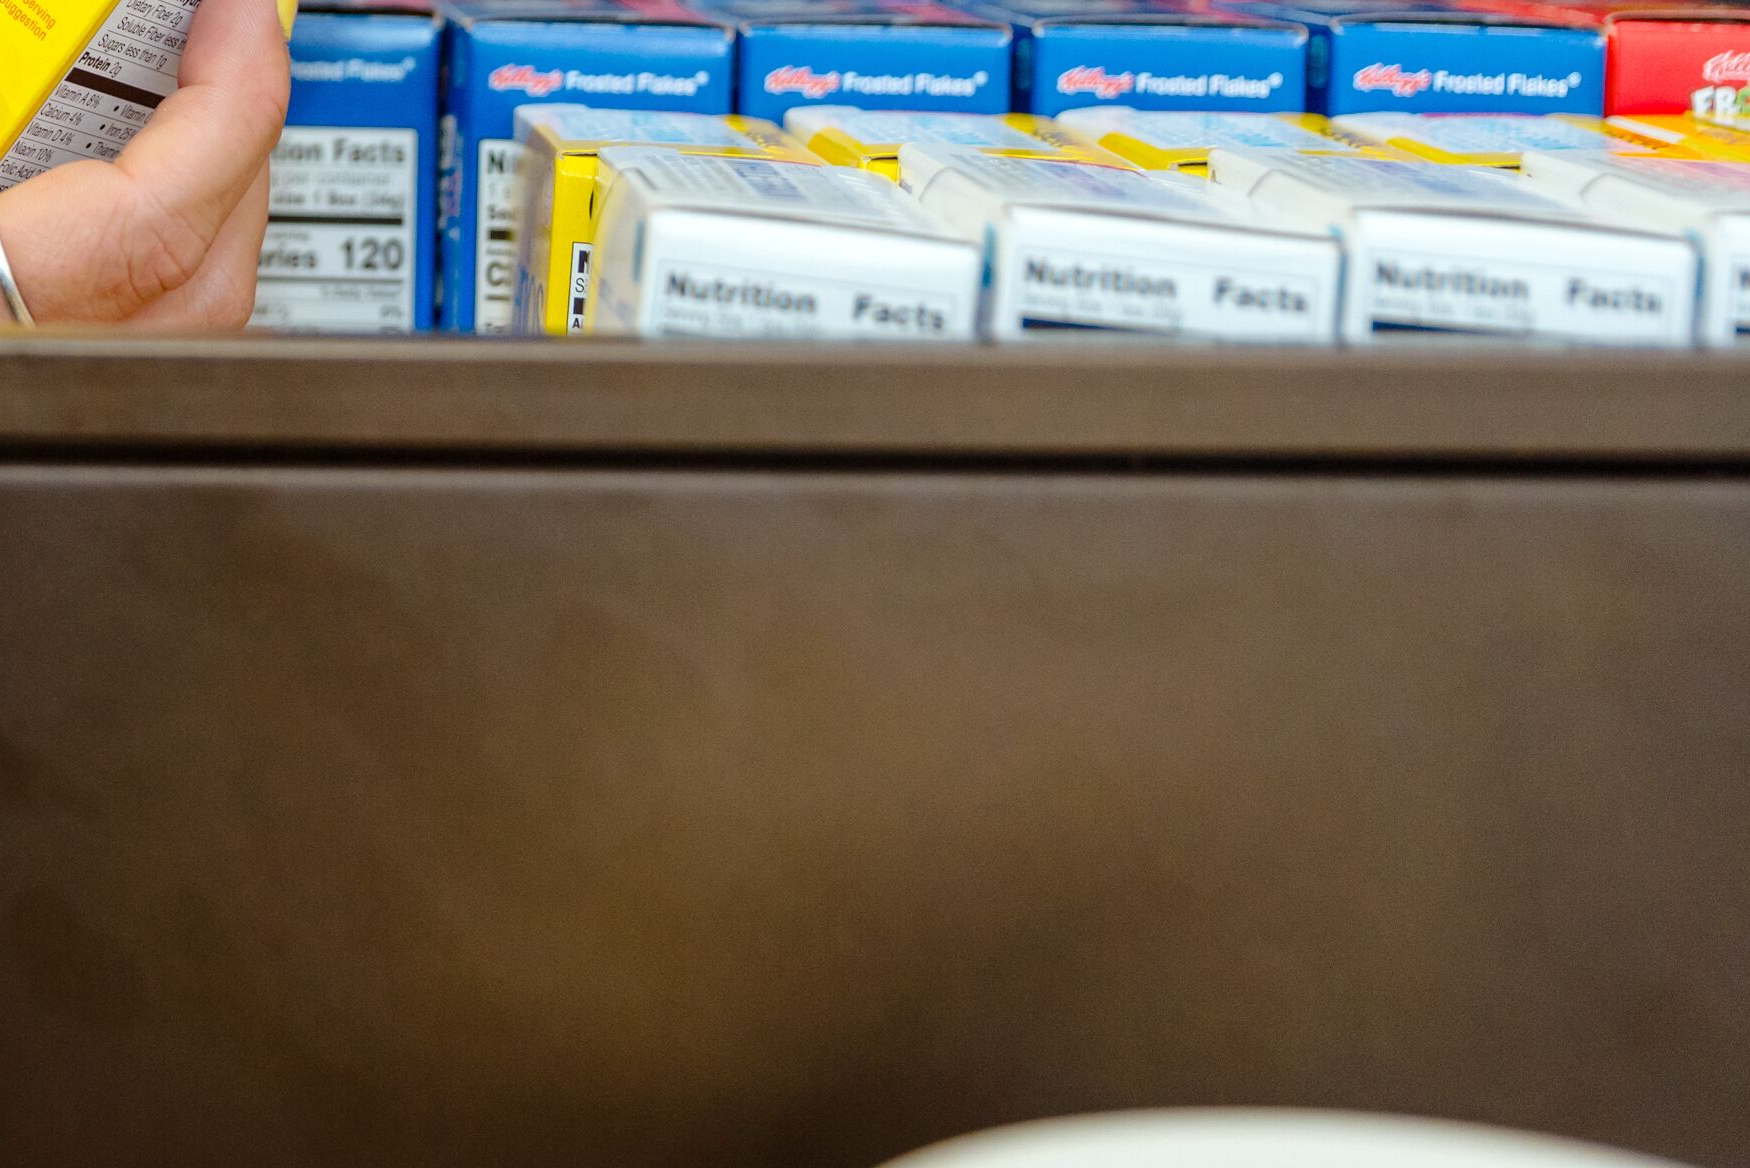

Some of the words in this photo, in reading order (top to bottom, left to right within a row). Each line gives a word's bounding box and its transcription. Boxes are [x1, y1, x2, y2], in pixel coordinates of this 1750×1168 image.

[153, 4, 175, 22] Fiber
[171, 12, 183, 27] 2g
[116, 16, 148, 37] Soluble
[146, 28, 165, 46] Fiber
[163, 33, 181, 48] less
[97, 34, 126, 54] Sugars
[123, 43, 141, 59] less
[139, 47, 158, 63] than
[154, 54, 168, 70] 1g
[78, 51, 111, 72] Protein
[107, 61, 123, 79] 2g
[54, 83, 82, 103] Vitamin
[80, 92, 89, 105] A
[40, 102, 70, 121] Calcium
[121, 104, 146, 121] Vitamin
[26, 122, 54, 141] Vitamin
[51, 129, 62, 142] D
[105, 122, 121, 137] Iron
[11, 140, 36, 157] Niacin
[332, 139, 404, 163] Facts
[257, 249, 317, 269] ories
[340, 236, 405, 271] 120
[1025, 258, 1178, 297] Nutrition
[1213, 277, 1308, 312] Facts
[1374, 261, 1530, 299] Nutrition
[1566, 278, 1662, 312] Facts
[665, 271, 817, 313] Nutrition
[852, 292, 945, 329] Facts
